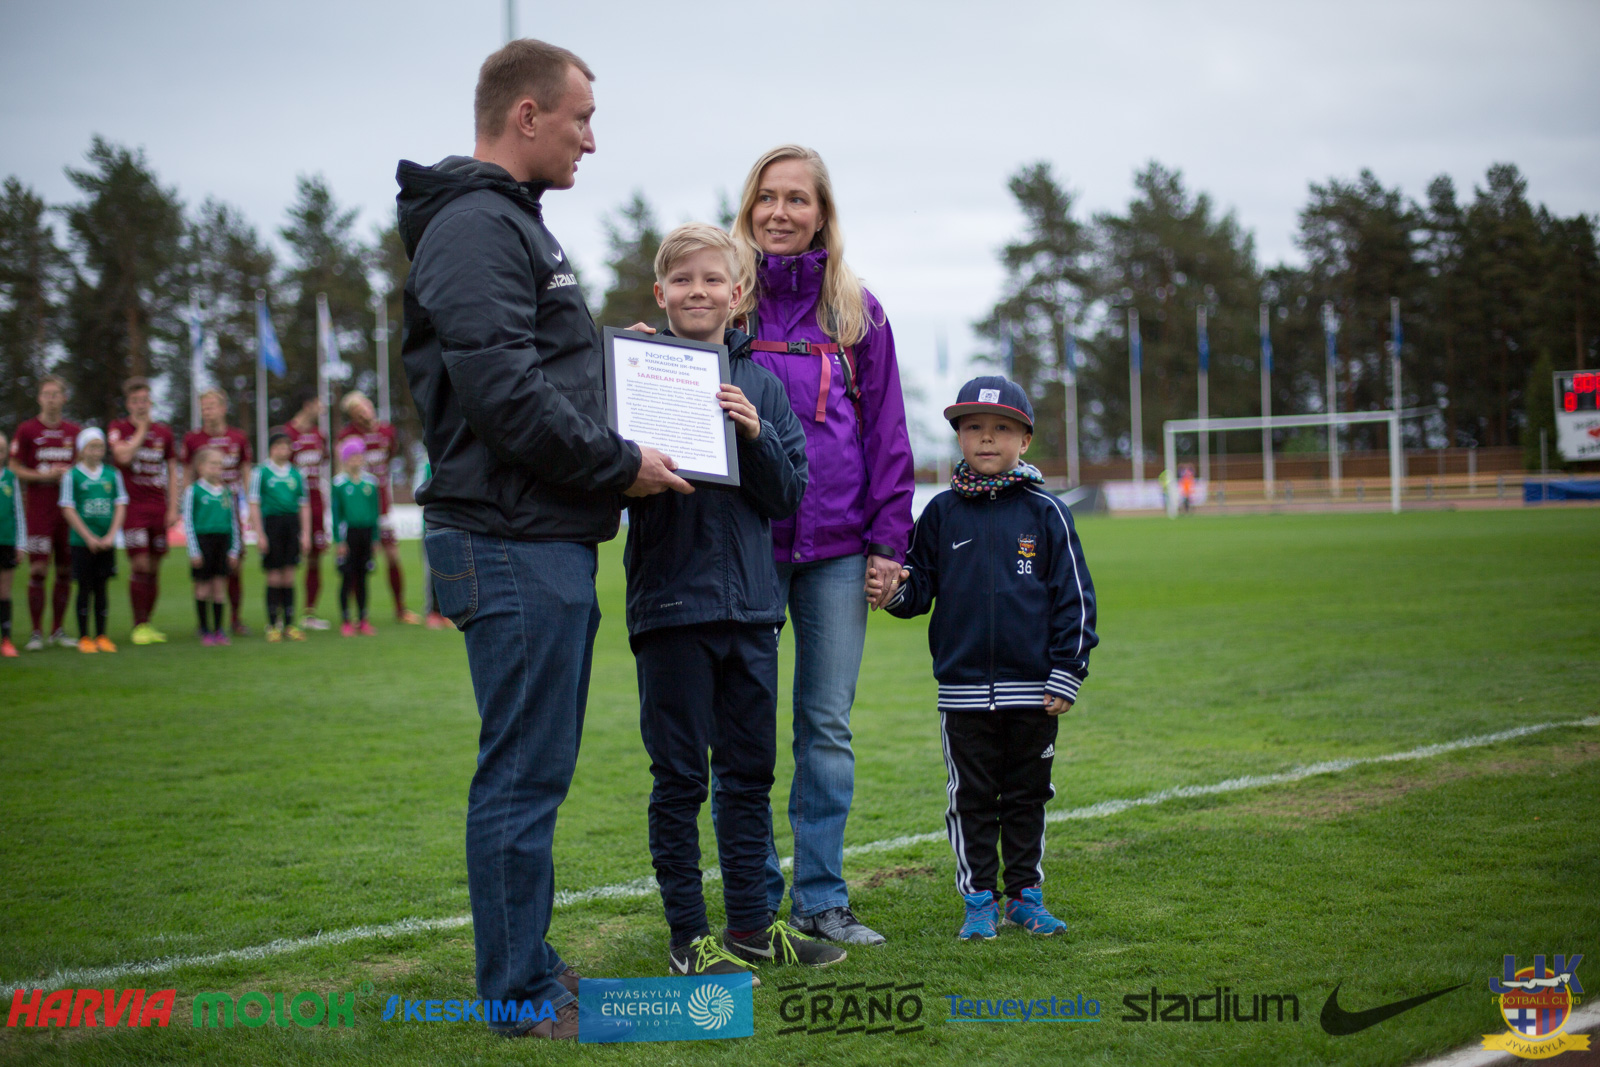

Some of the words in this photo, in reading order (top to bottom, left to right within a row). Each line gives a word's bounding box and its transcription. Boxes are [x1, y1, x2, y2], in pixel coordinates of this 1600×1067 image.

[645, 352, 683, 363] Nordea
[637, 372, 674, 383] SAARELAN
[676, 377, 700, 386] PERHE
[1016, 559, 1033, 575] 36
